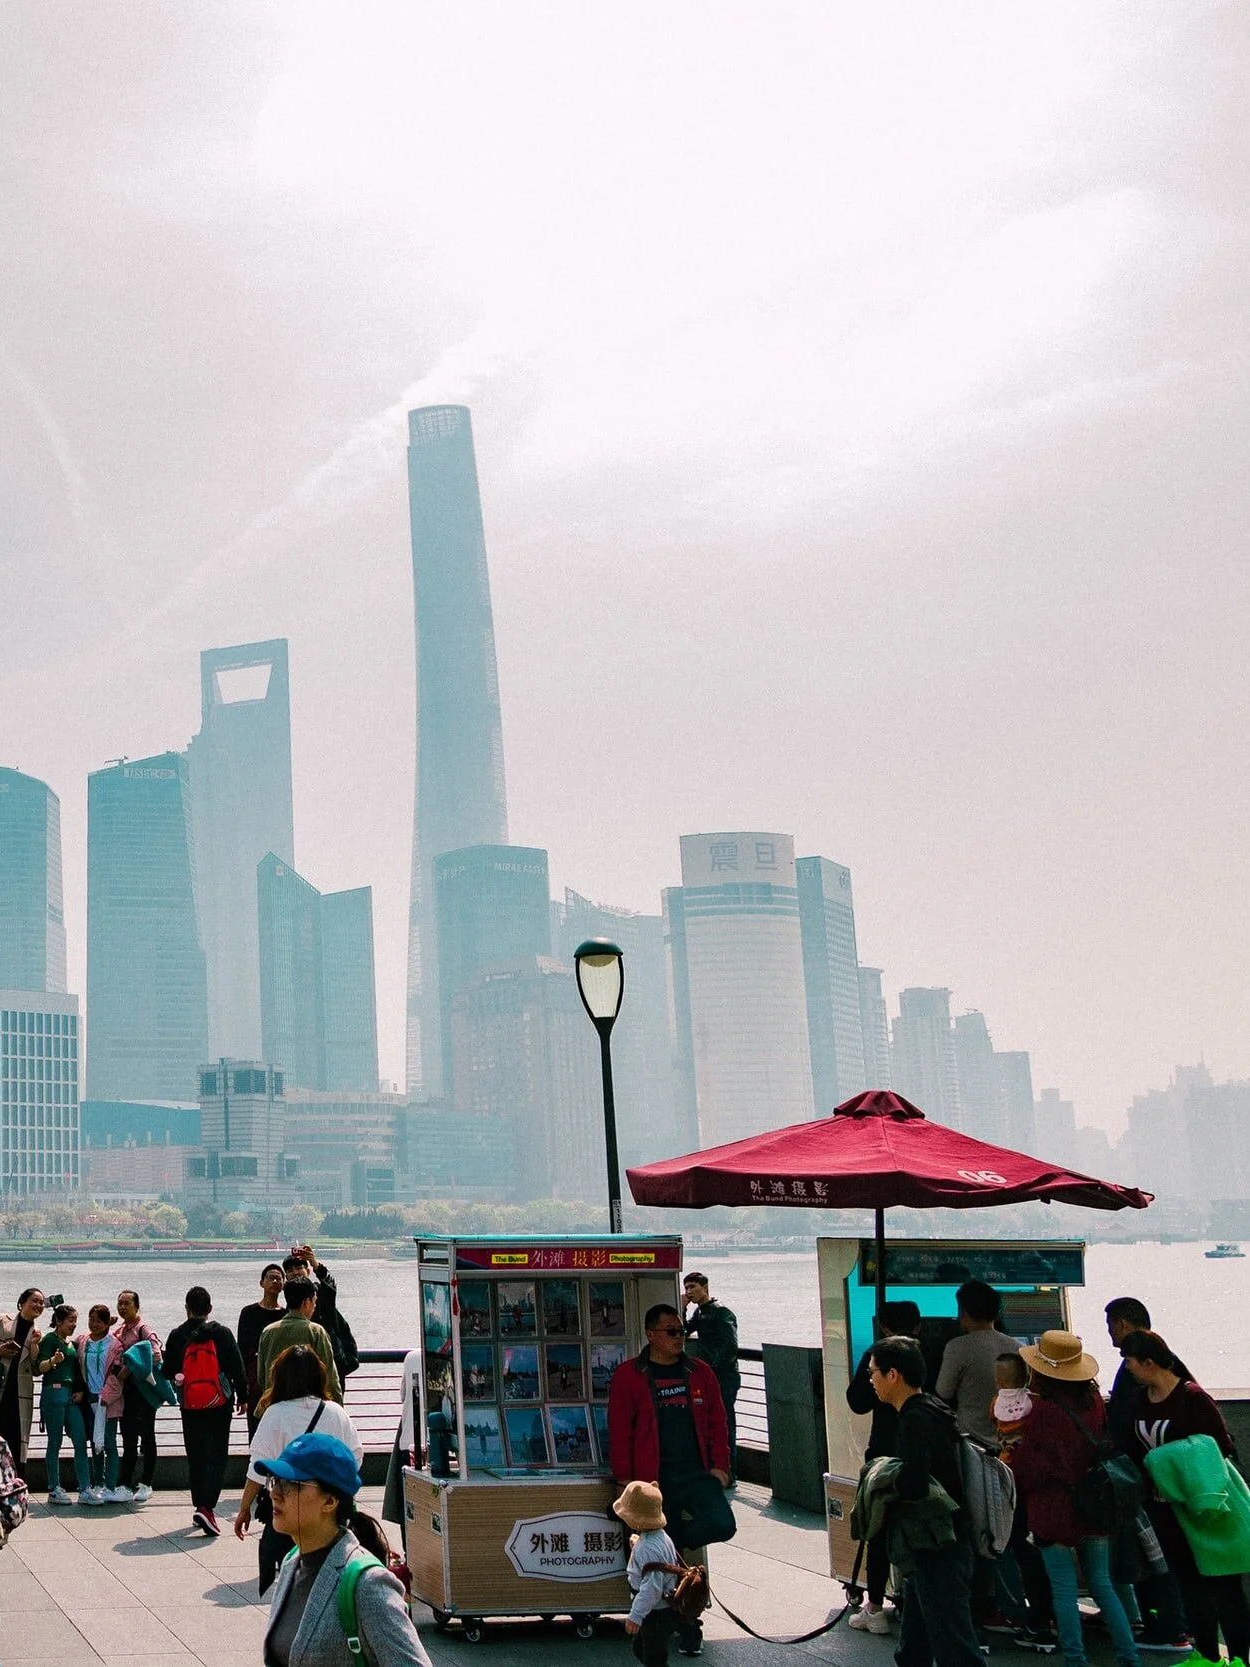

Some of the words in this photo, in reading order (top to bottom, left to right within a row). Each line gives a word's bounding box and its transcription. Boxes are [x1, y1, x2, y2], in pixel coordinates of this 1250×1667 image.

[709, 841, 777, 872] 震旦
[494, 862, 522, 873] MIRAE
[957, 1169, 1007, 1184] 06
[784, 1196, 828, 1204] Photography
[531, 1250, 565, 1267] 外滩
[573, 1250, 606, 1267] 摄影
[611, 1255, 653, 1263] Photography
[530, 1532, 570, 1553] 外滩
[583, 1532, 623, 1552] 摄影
[540, 1556, 615, 1566] PHOTOGRAPHY
